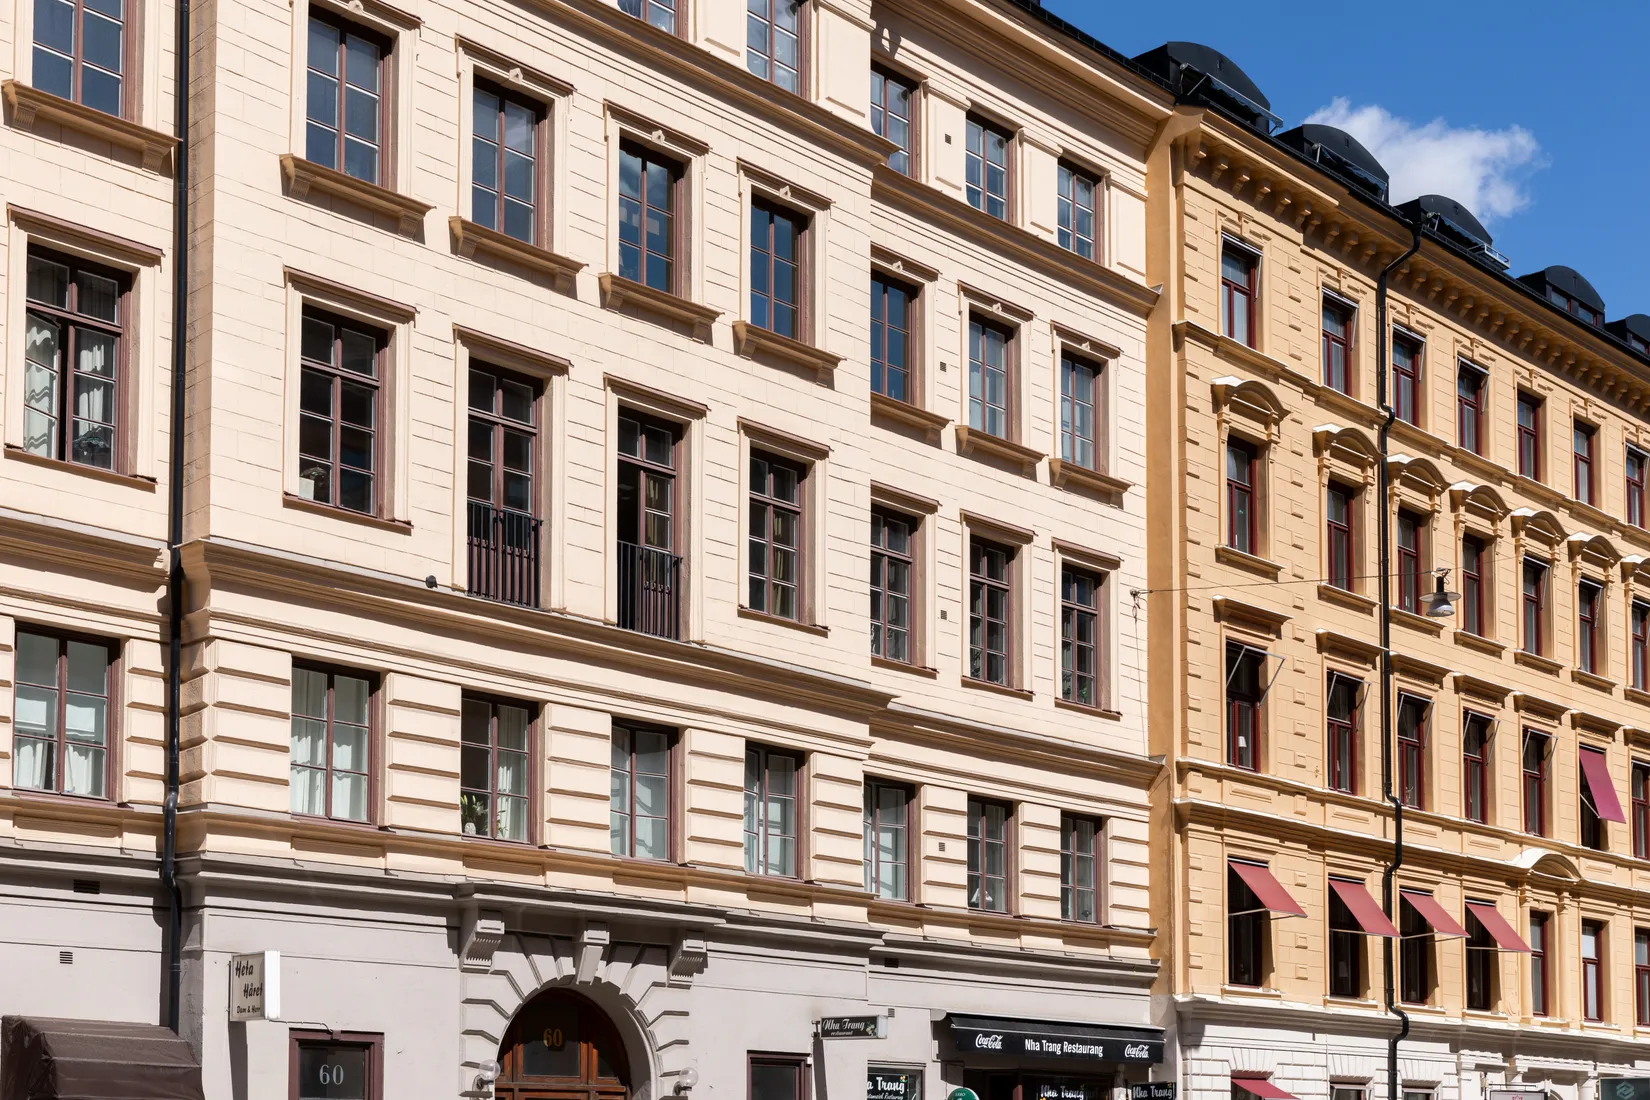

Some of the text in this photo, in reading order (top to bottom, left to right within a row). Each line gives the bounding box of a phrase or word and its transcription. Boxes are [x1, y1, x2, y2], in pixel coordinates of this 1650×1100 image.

[243, 982, 263, 999] Håret
[823, 1018, 866, 1032] Nha Trang
[543, 1028, 563, 1047] 60
[1024, 1038, 1104, 1057] Nha Trang Restaurang
[319, 1064, 345, 1085] 60
[876, 1076, 905, 1095] Trang
[1040, 1085, 1084, 1100] Nha Trang
[1132, 1085, 1173, 1099] Nha Trang
